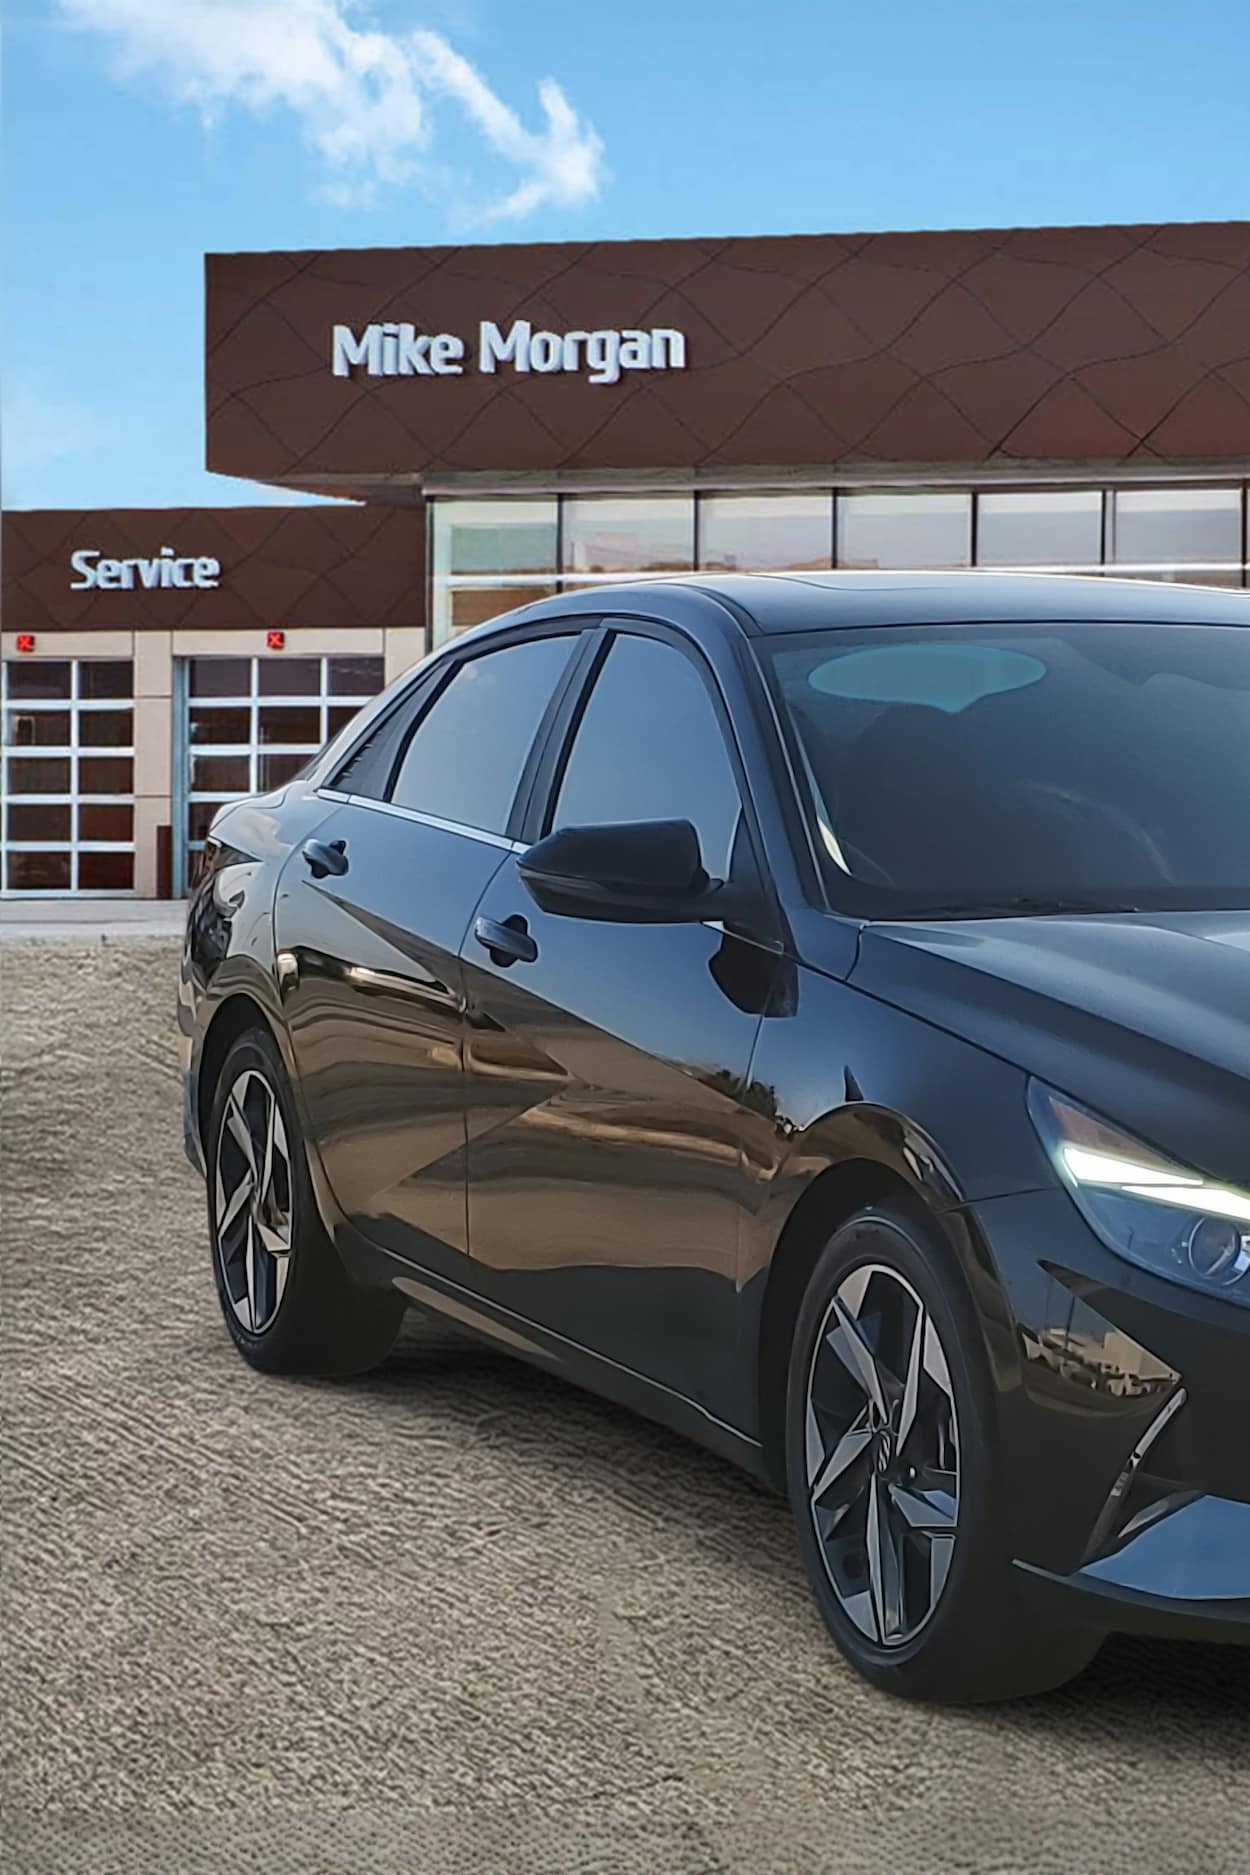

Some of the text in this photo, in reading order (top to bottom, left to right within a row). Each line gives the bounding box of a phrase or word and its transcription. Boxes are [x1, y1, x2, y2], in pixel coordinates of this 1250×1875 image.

[332, 320, 686, 384] Mike Morgan
[70, 547, 221, 590] Service
